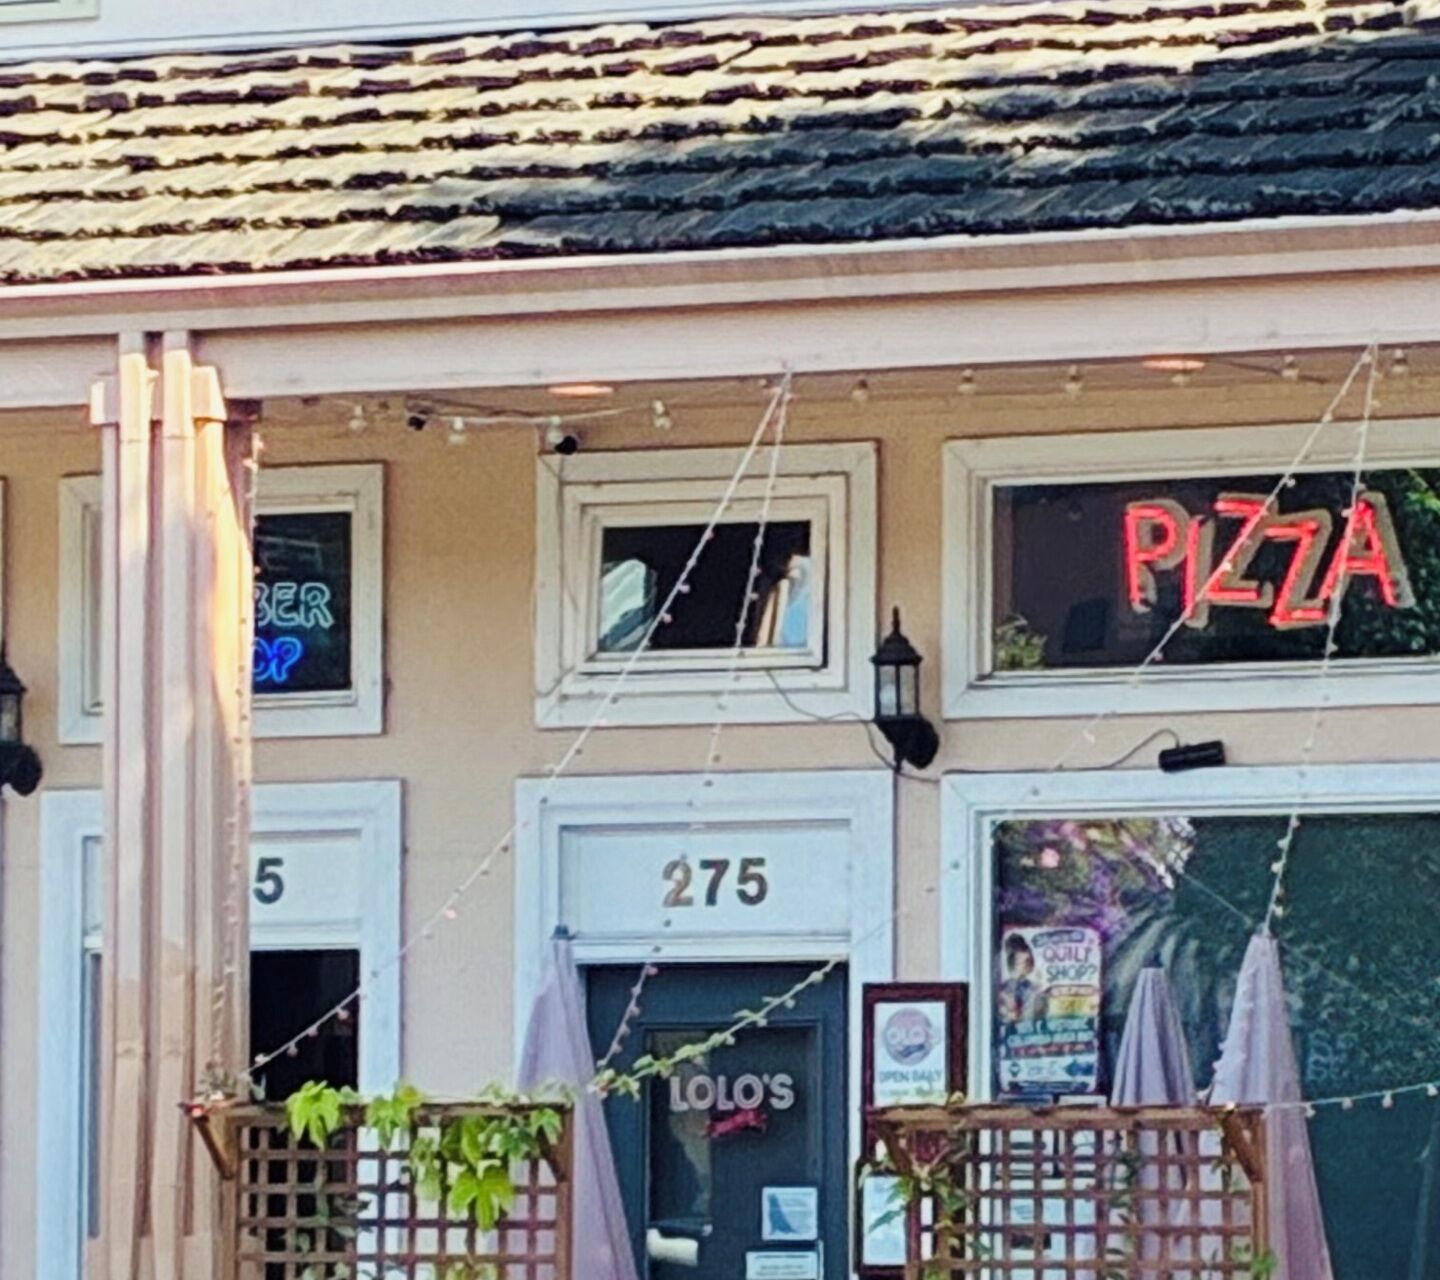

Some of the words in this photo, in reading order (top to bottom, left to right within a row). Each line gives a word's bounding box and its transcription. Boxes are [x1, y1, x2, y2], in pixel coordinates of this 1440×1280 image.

[1123, 494, 1405, 627] PIZZA
[662, 857, 768, 908] 275
[1043, 946, 1092, 963] QUILT
[669, 1073, 794, 1111] LOLO'S
